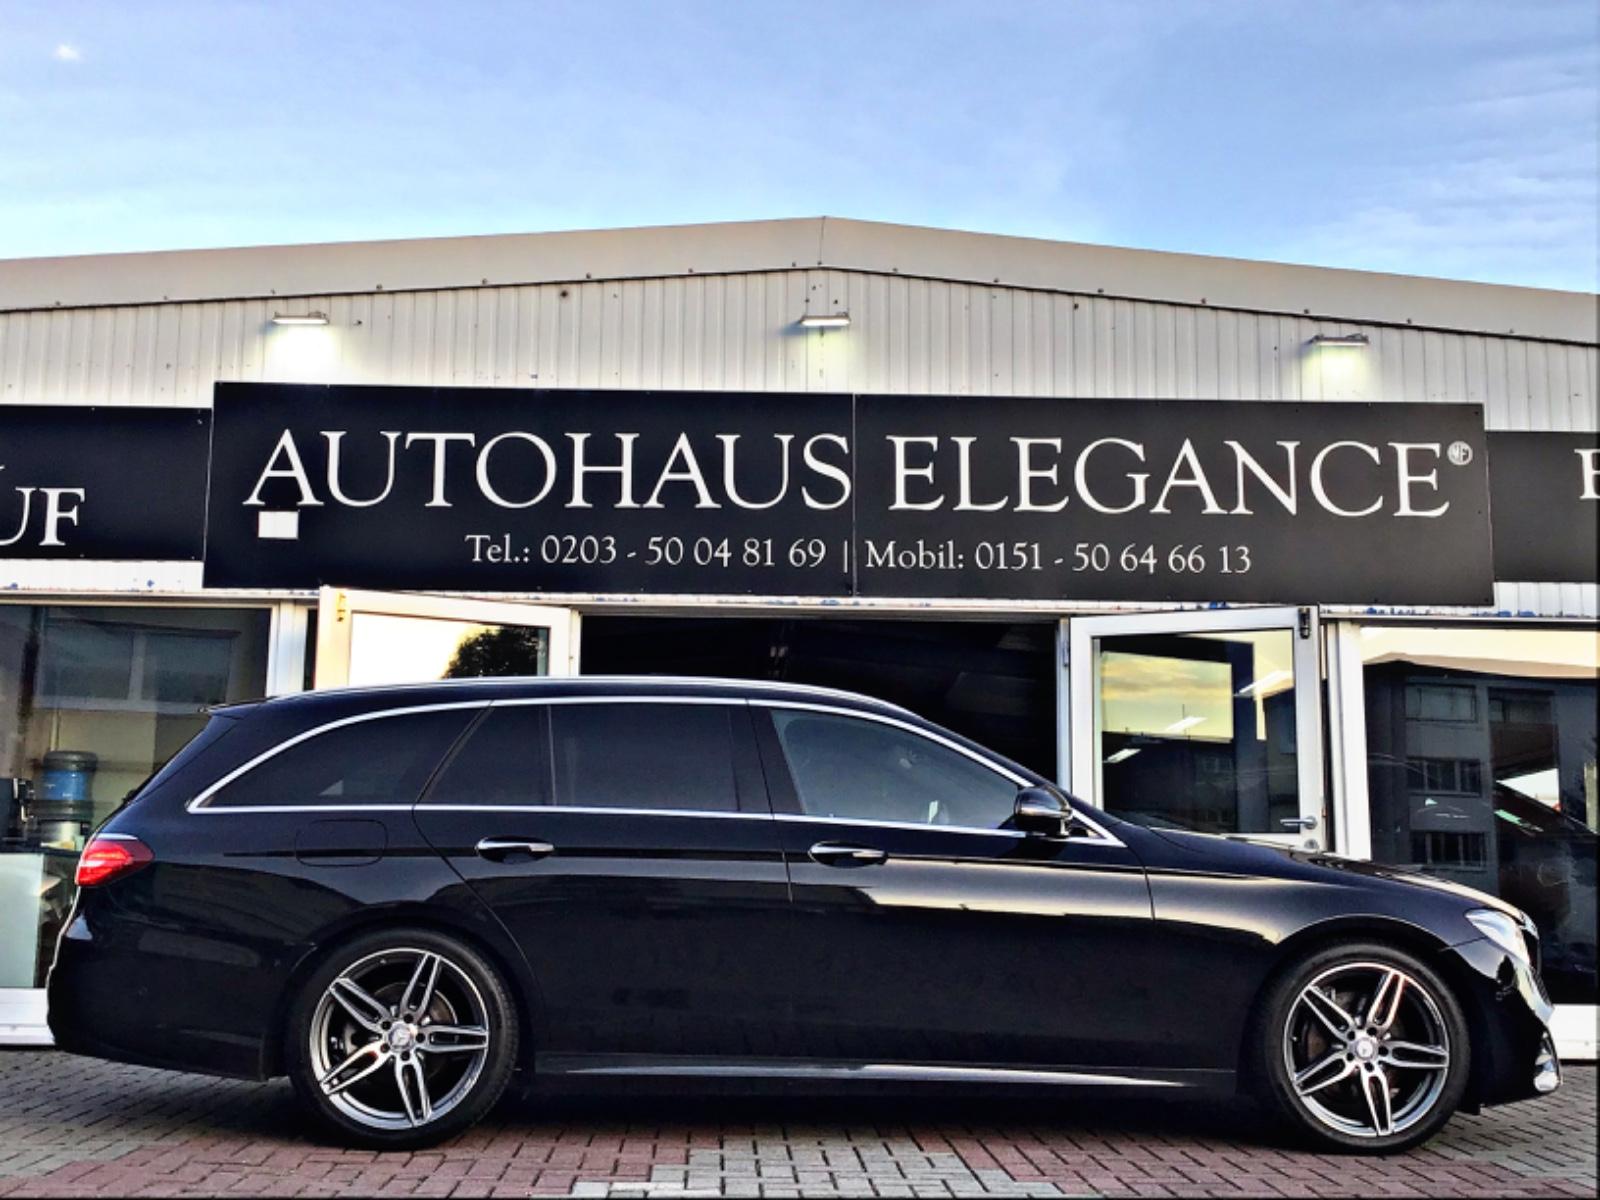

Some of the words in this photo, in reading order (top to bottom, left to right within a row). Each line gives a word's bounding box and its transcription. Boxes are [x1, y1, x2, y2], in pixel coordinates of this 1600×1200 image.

[242, 428, 852, 510] AUTOHAUS
[886, 435, 1450, 519] ELEGANCE
[465, 533, 530, 563] Tel.:
[541, 534, 617, 564] 0203
[648, 536, 684, 565] 50
[693, 537, 732, 568] 04
[742, 538, 775, 566] 81
[788, 538, 826, 568] 69
[865, 539, 964, 569] Mobil:
[975, 541, 1043, 571] 0151
[1073, 542, 1110, 572] 50
[1119, 543, 1158, 574] 64
[1167, 544, 1206, 574] 66
[1219, 545, 1252, 574] 13
